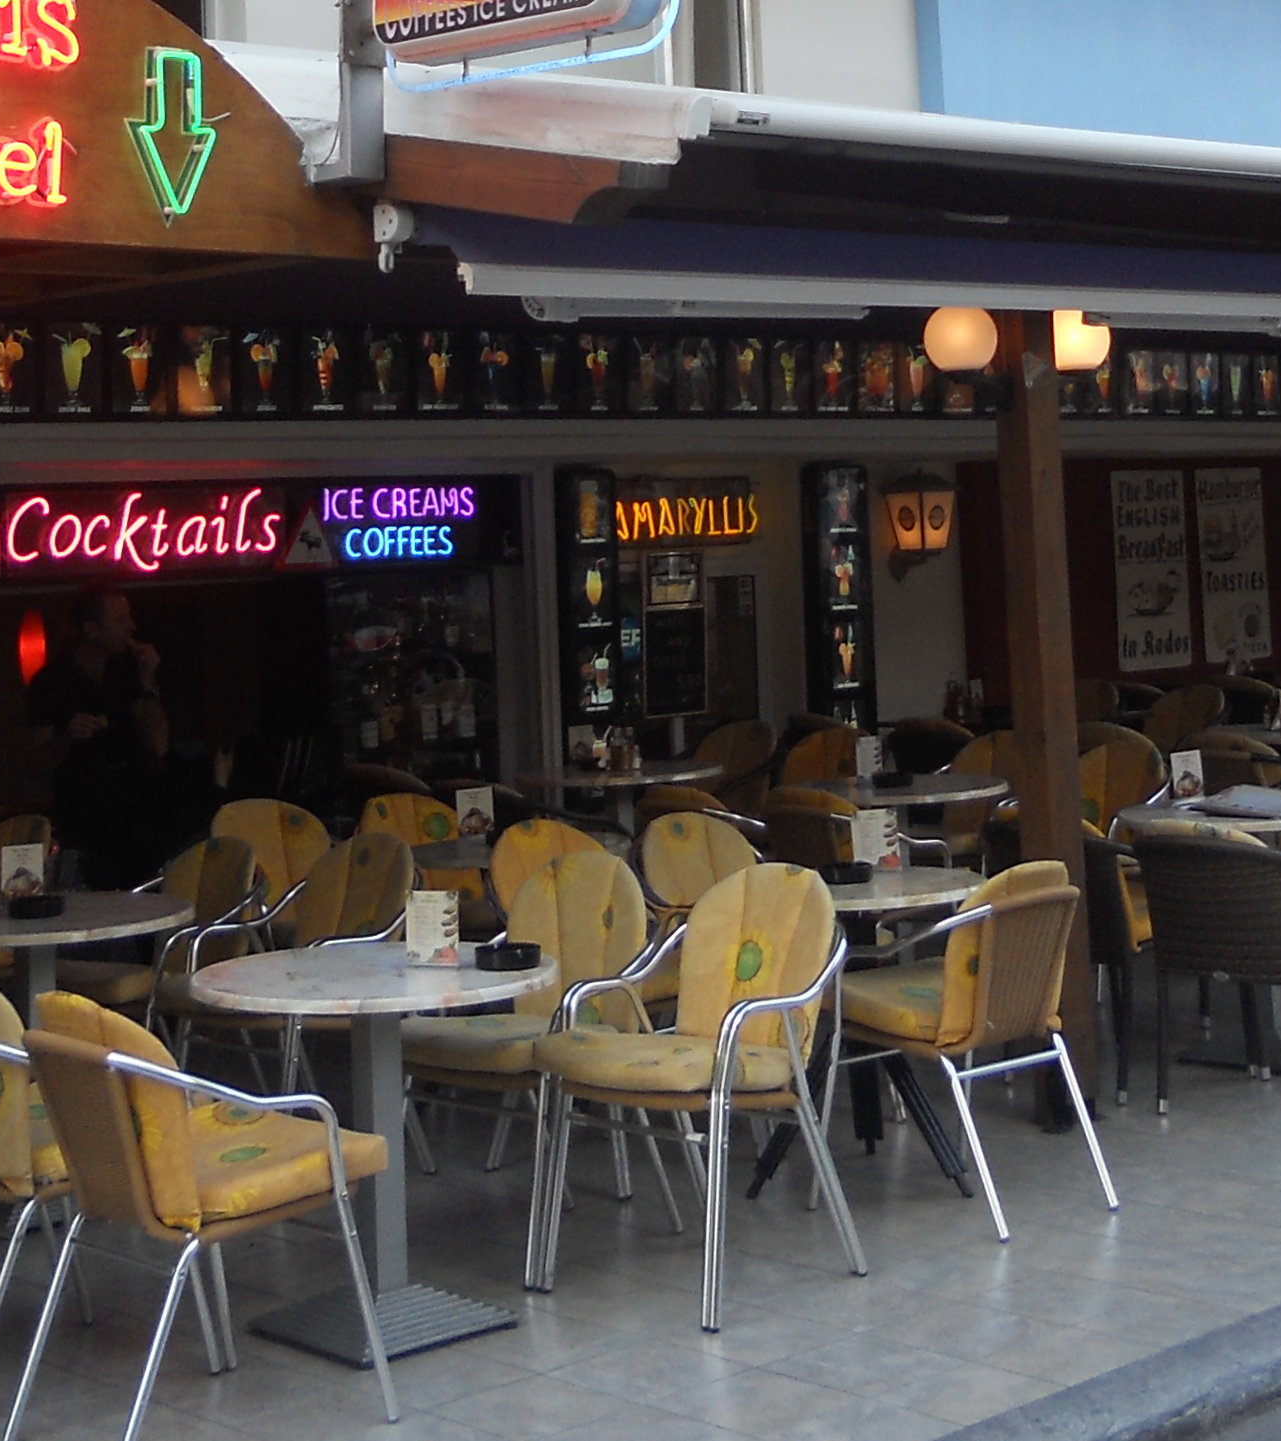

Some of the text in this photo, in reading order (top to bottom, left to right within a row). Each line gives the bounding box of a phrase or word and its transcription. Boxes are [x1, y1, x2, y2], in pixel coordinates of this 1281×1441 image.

[322, 486, 476, 522] ICE CREAMS
[1117, 505, 1180, 528] ENGLISH
[5, 487, 282, 570] Cocktails
[344, 525, 455, 559] COFFEES
